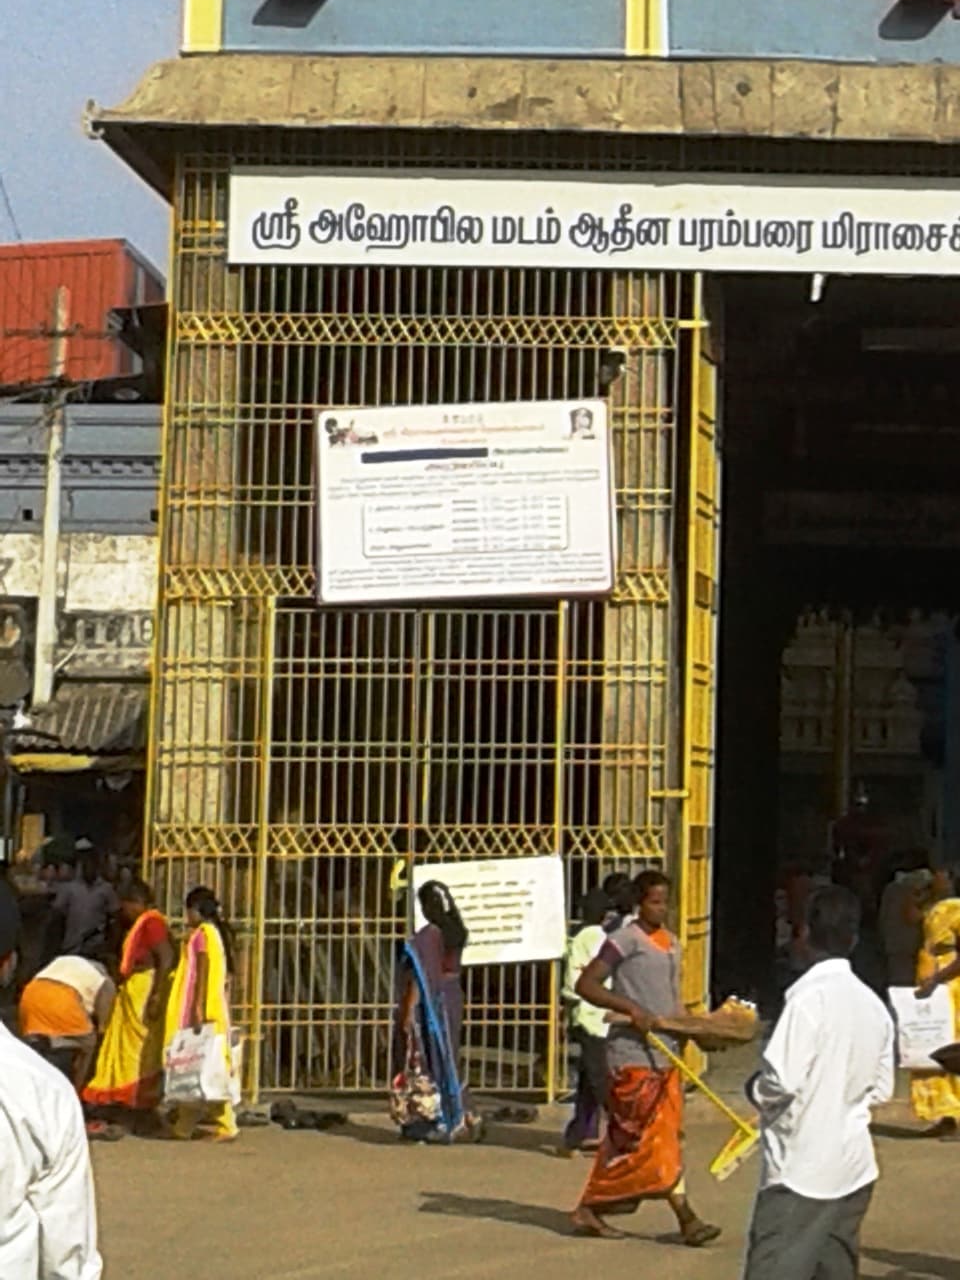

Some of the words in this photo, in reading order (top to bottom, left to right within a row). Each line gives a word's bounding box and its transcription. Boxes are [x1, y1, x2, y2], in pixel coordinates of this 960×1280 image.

[308, 203, 484, 252] அஹோபில
[492, 207, 561, 245] மடம்
[568, 202, 671, 254] ஆதீன
[679, 209, 814, 254] பரம்பரை
